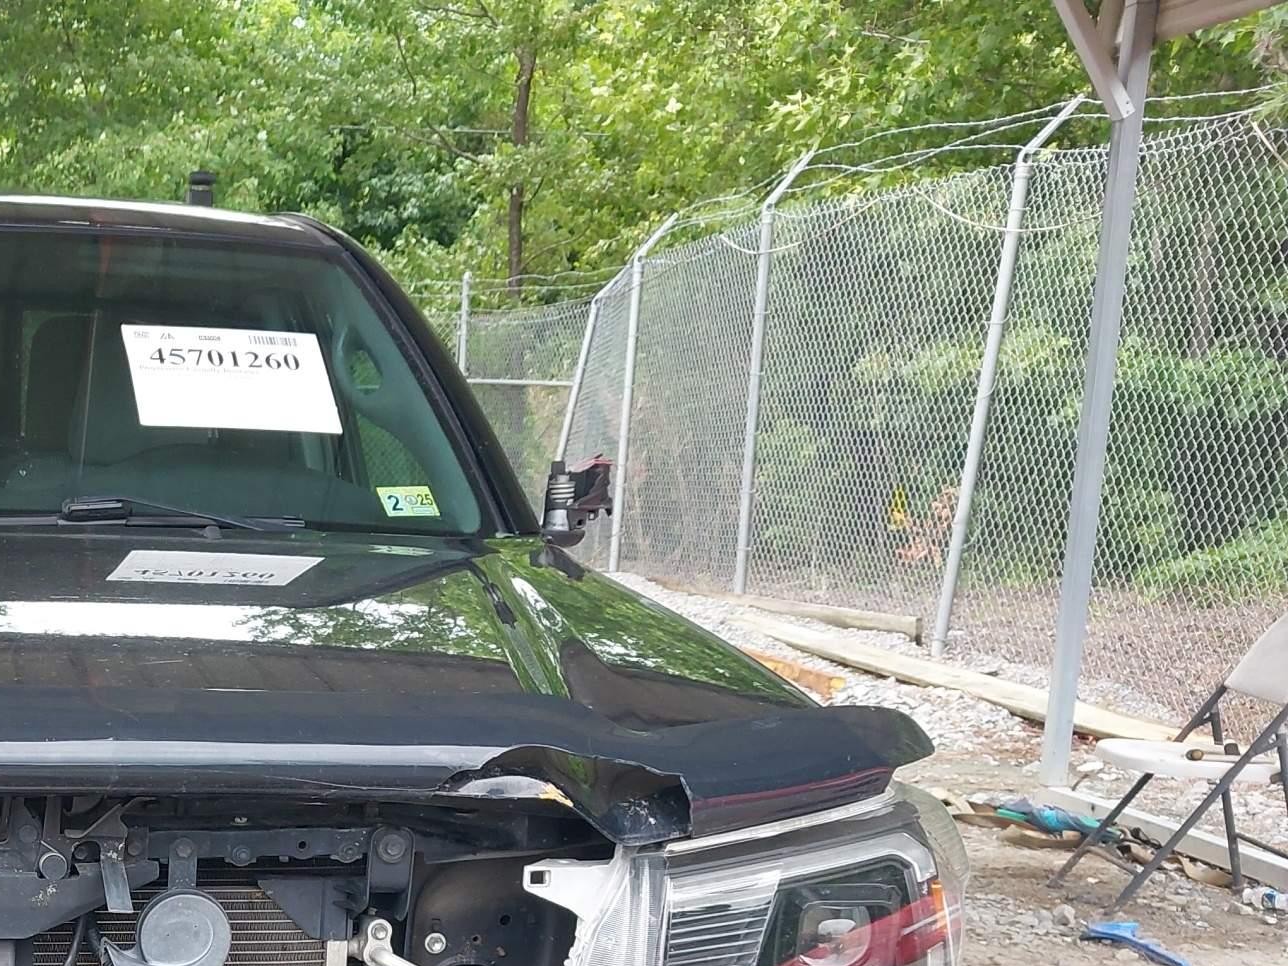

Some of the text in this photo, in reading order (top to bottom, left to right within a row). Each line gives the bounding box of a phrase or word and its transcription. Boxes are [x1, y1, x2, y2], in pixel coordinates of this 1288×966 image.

[149, 346, 300, 371] 45701260
[387, 493, 433, 511] 2 25
